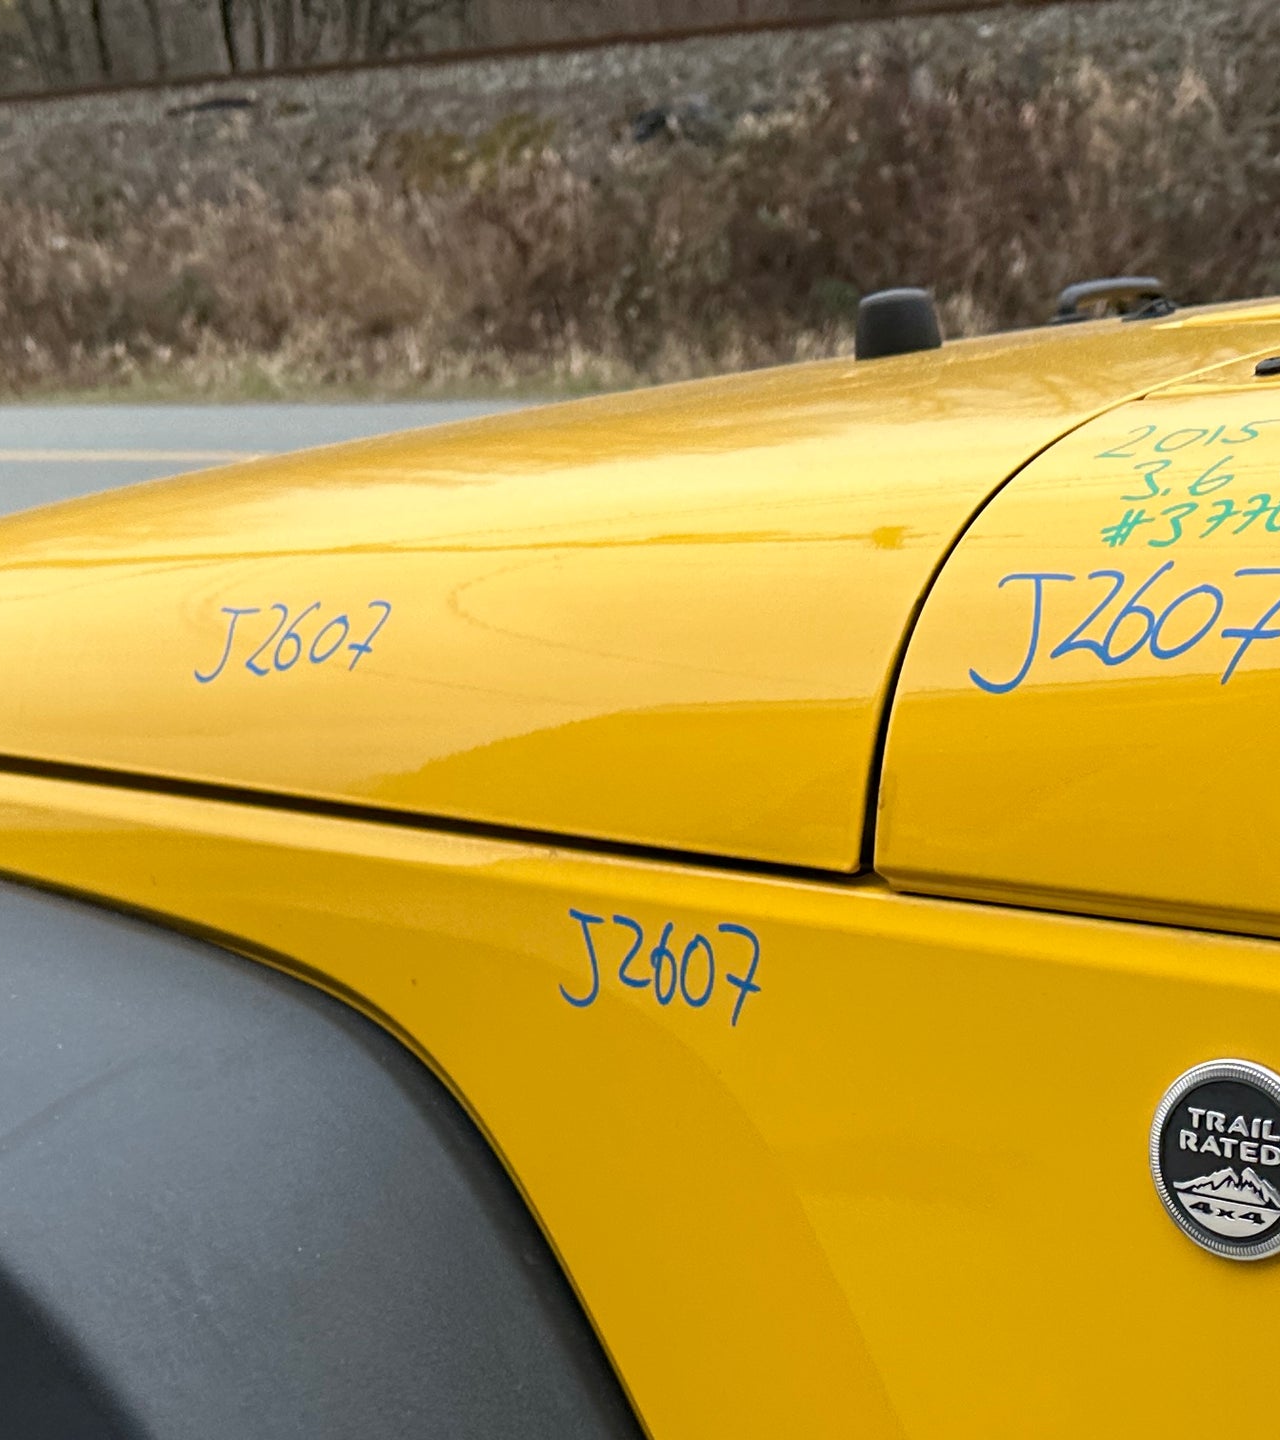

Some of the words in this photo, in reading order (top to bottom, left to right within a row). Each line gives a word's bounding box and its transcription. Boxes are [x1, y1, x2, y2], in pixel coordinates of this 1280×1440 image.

[1120, 454, 1234, 501] 3.6
[194, 601, 392, 684] J2607
[559, 908, 762, 1026] J2607
